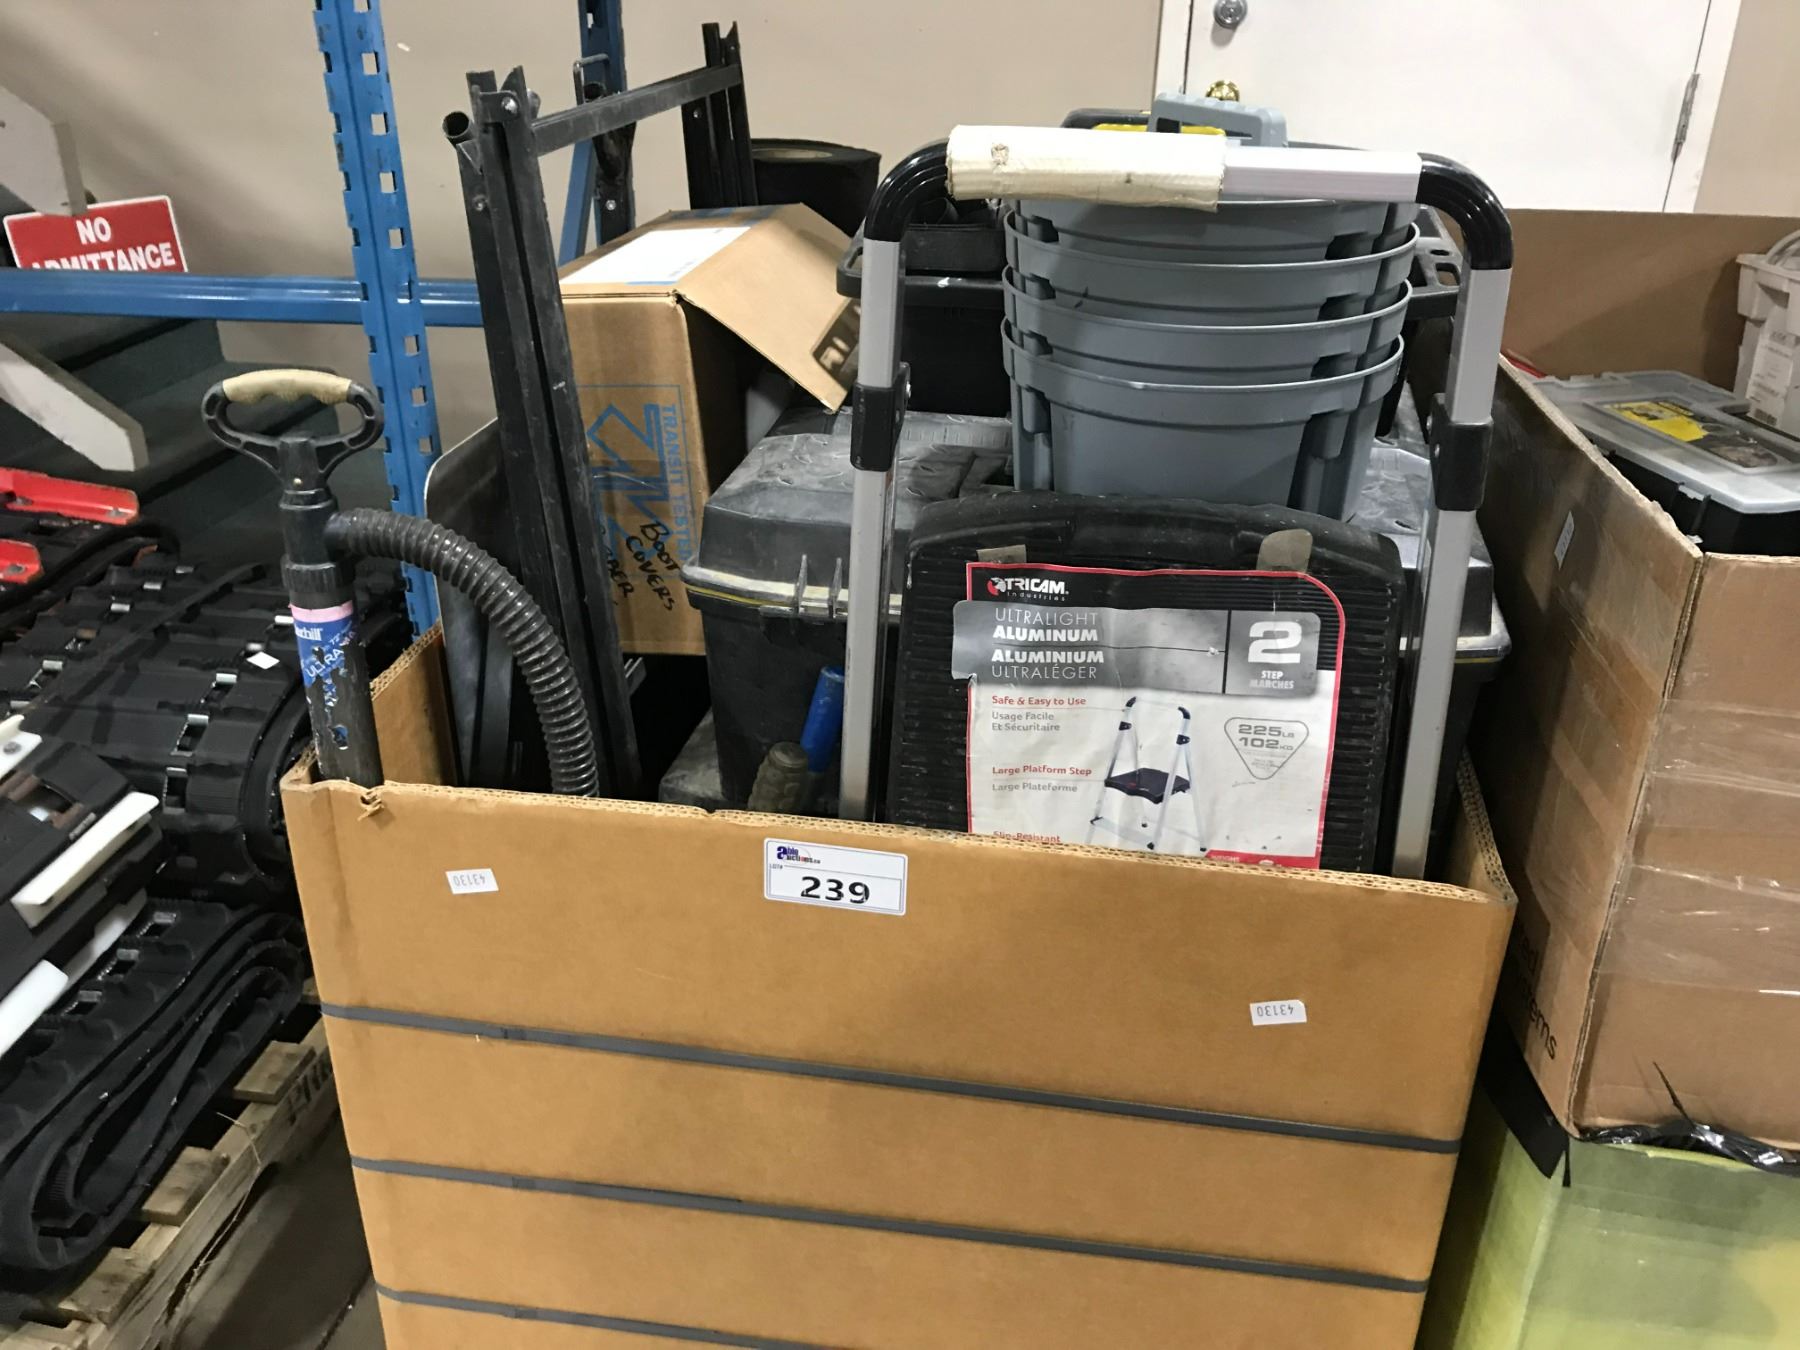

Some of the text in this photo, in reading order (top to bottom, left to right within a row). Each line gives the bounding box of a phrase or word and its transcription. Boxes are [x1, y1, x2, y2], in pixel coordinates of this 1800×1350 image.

[76, 217, 112, 245] NO
[32, 243, 176, 271] MITTANCE
[662, 403, 684, 484] TRANSIT
[626, 535, 675, 611] COVERS
[1004, 578, 1065, 595] TRICAM
[995, 607, 1099, 626] ULTRALIGHT
[992, 625, 1098, 642] ALUMINUM
[1248, 621, 1302, 664] 2
[991, 649, 1105, 664] ALUMINIUM
[991, 663, 1097, 679] ULTRALÉGER
[1261, 670, 1284, 679] STEP
[1250, 679, 1295, 690] MARCHES
[992, 695, 1086, 707] Safe & Easy to Use
[992, 711, 1055, 721] Usage Facile
[992, 765, 1093, 776] Large Platform Step
[992, 782, 1078, 793] Large Plateforme
[452, 873, 486, 887] 43130
[800, 876, 870, 904] 239
[1256, 1003, 1294, 1017] 43130
